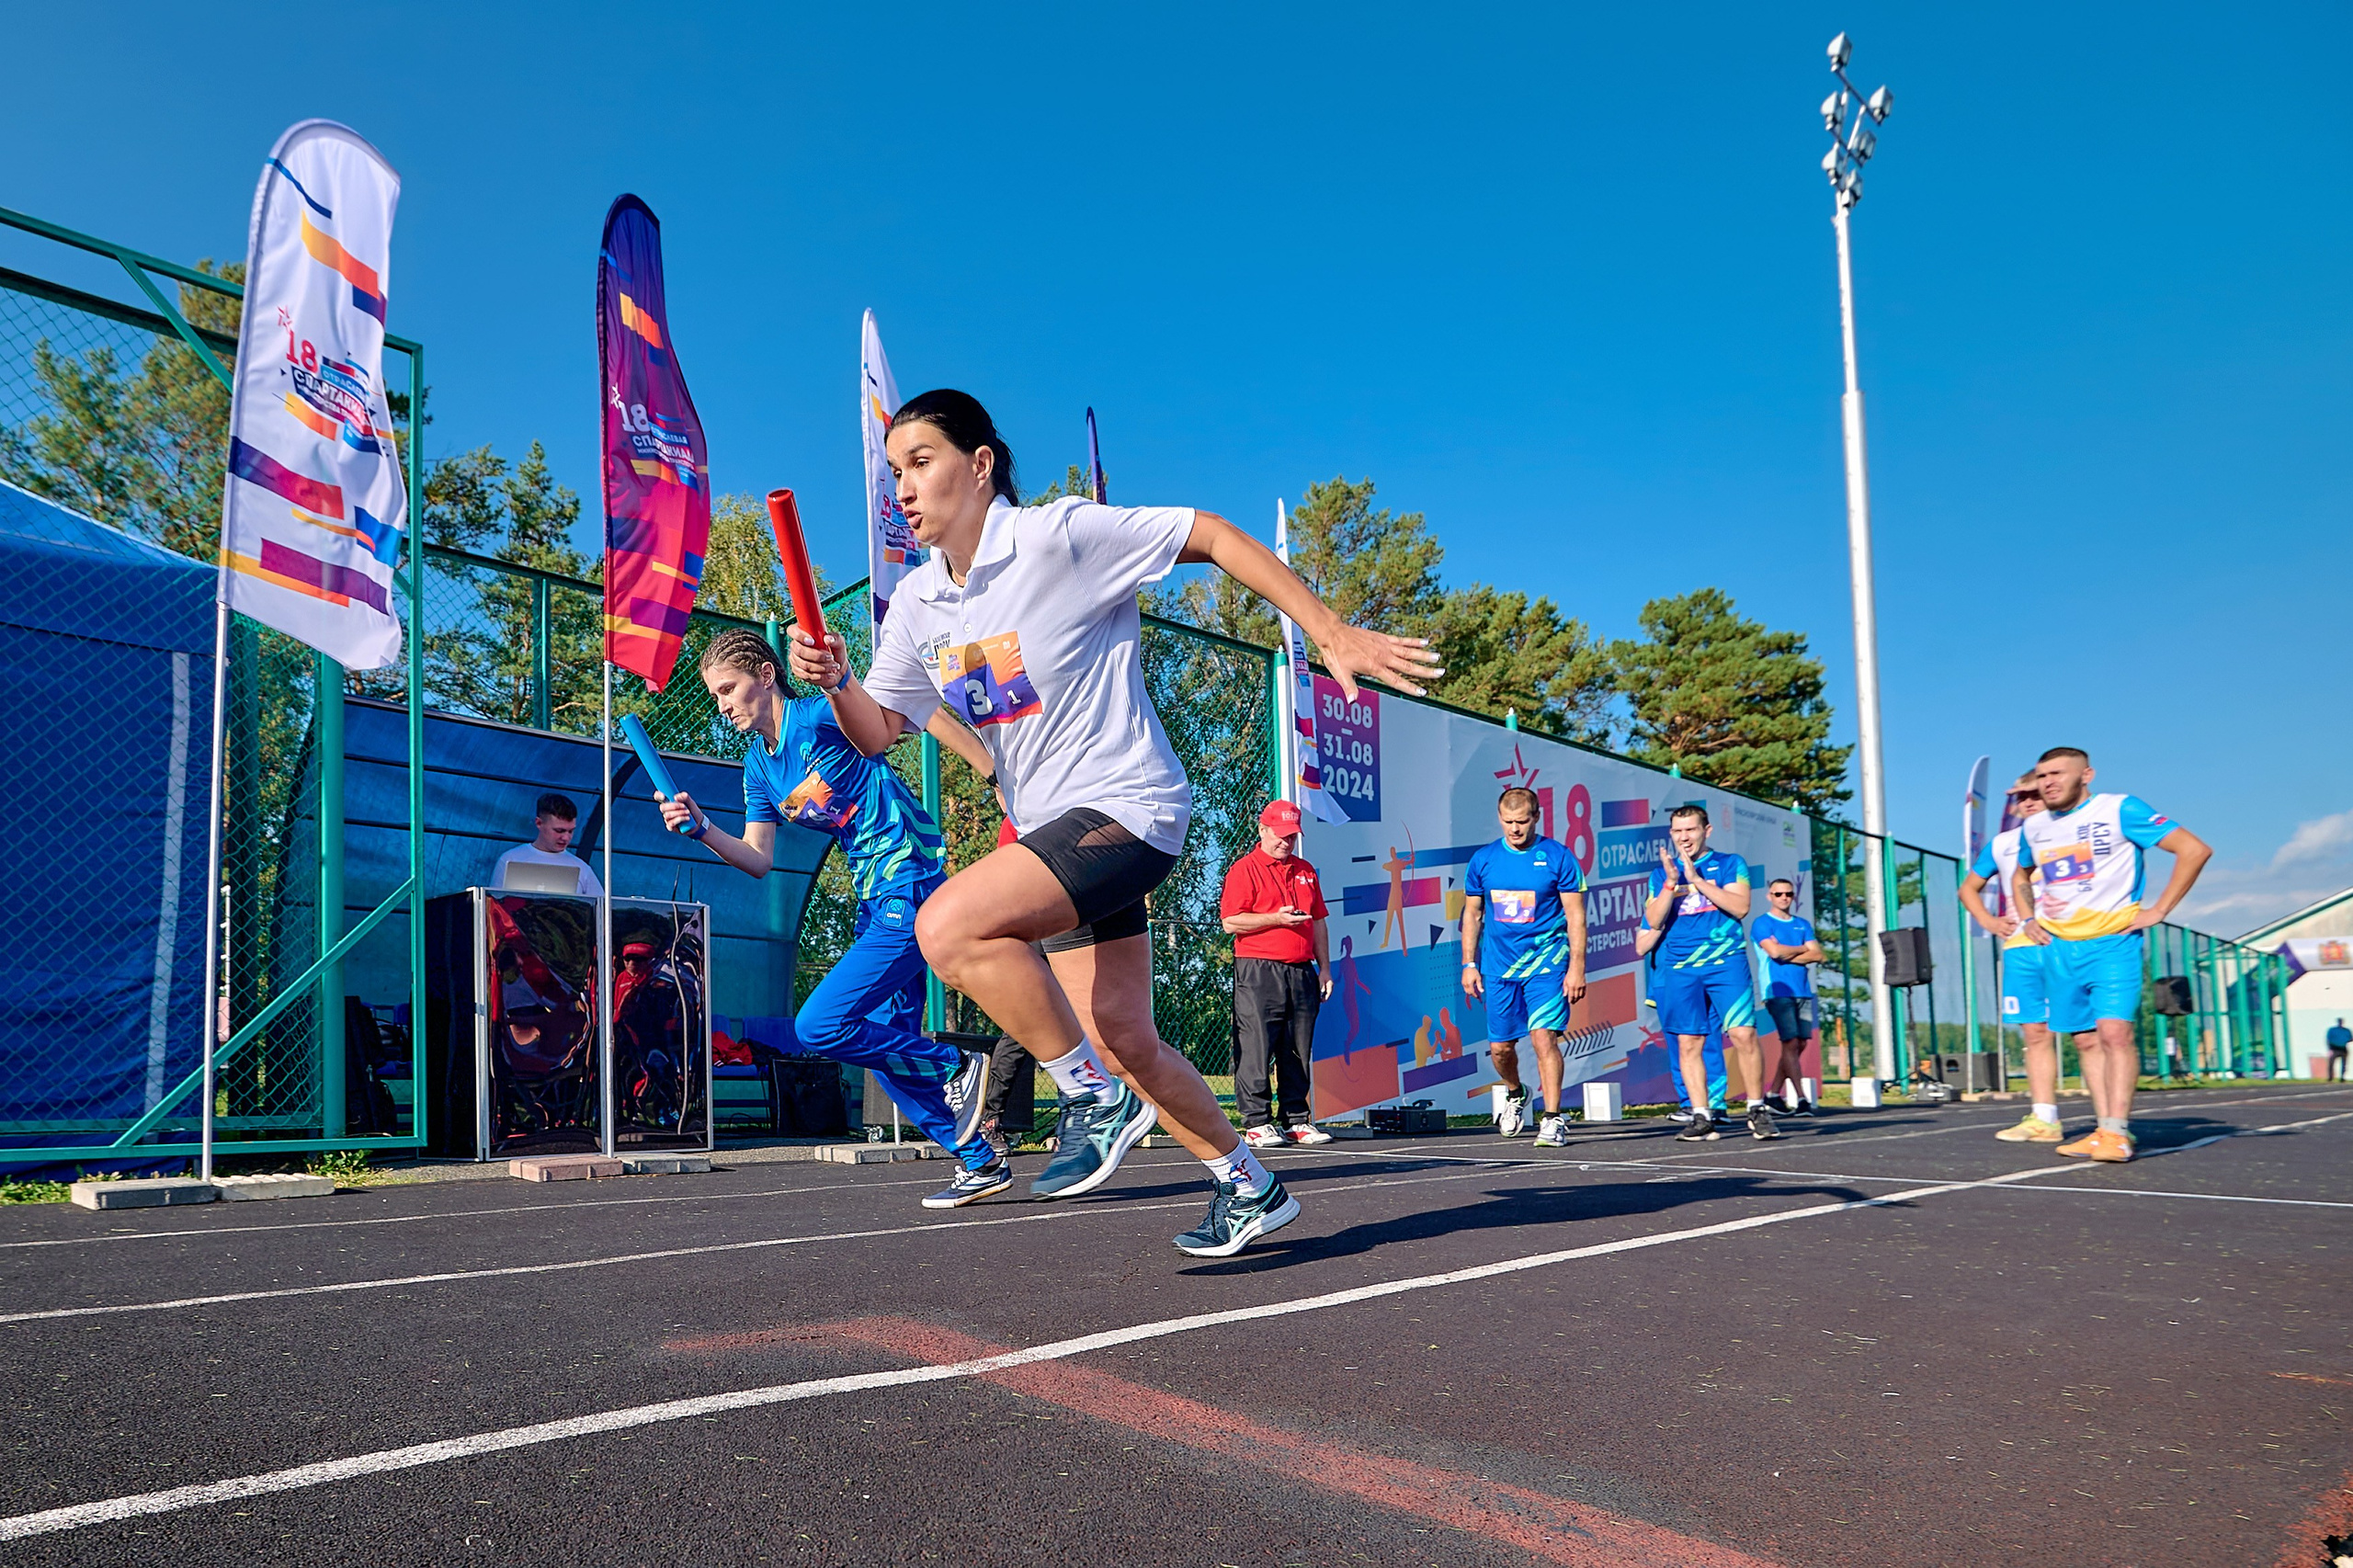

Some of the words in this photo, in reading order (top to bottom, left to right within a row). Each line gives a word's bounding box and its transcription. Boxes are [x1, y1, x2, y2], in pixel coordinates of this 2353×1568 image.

[286, 329, 319, 374] 18
[619, 401, 651, 432] 18
[965, 679, 994, 715] 3
[1007, 690, 1022, 705] 1
[1323, 694, 1373, 728] 30.08
[1324, 733, 1374, 767] 31.08
[1323, 765, 1374, 801] 2024
[830, 806, 841, 815] 1
[1538, 784, 1595, 877] 18
[2055, 859, 2071, 878] 3
[2078, 864, 2088, 873] 3
[1504, 901, 1518, 917] 4
